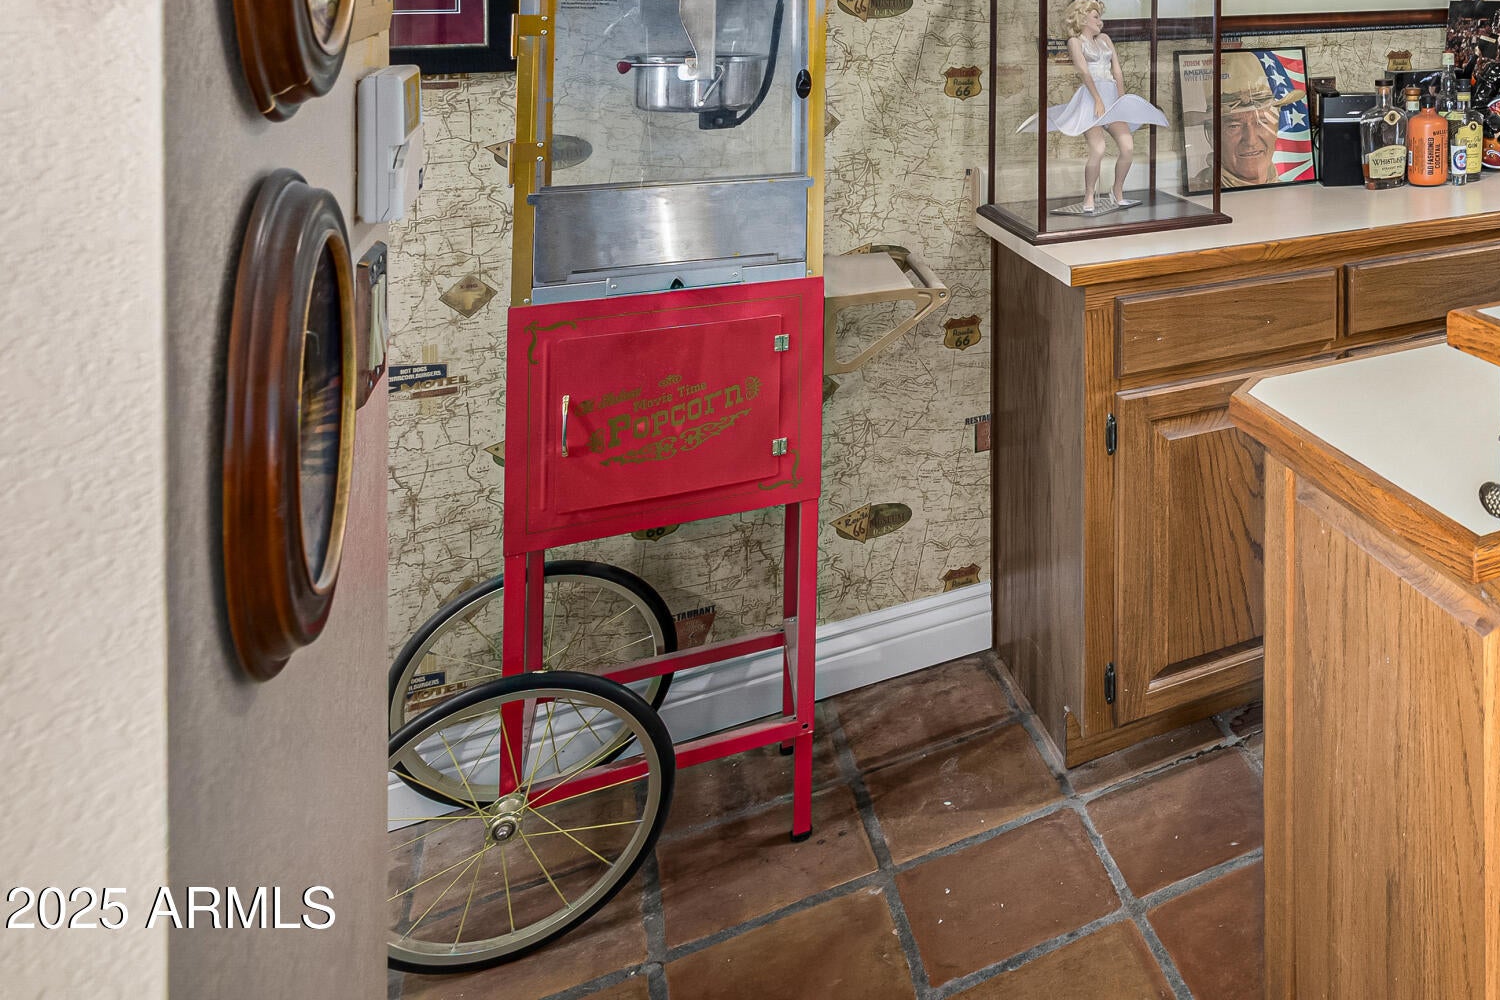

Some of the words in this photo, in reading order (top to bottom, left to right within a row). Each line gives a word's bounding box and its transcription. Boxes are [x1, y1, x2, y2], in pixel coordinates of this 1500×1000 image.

[854, 0, 867, 14] 66
[955, 85, 970, 97] 66
[955, 336, 970, 347] 66
[677, 382, 707, 397] Time
[608, 384, 744, 448] Popcorn
[853, 522, 866, 537] 66
